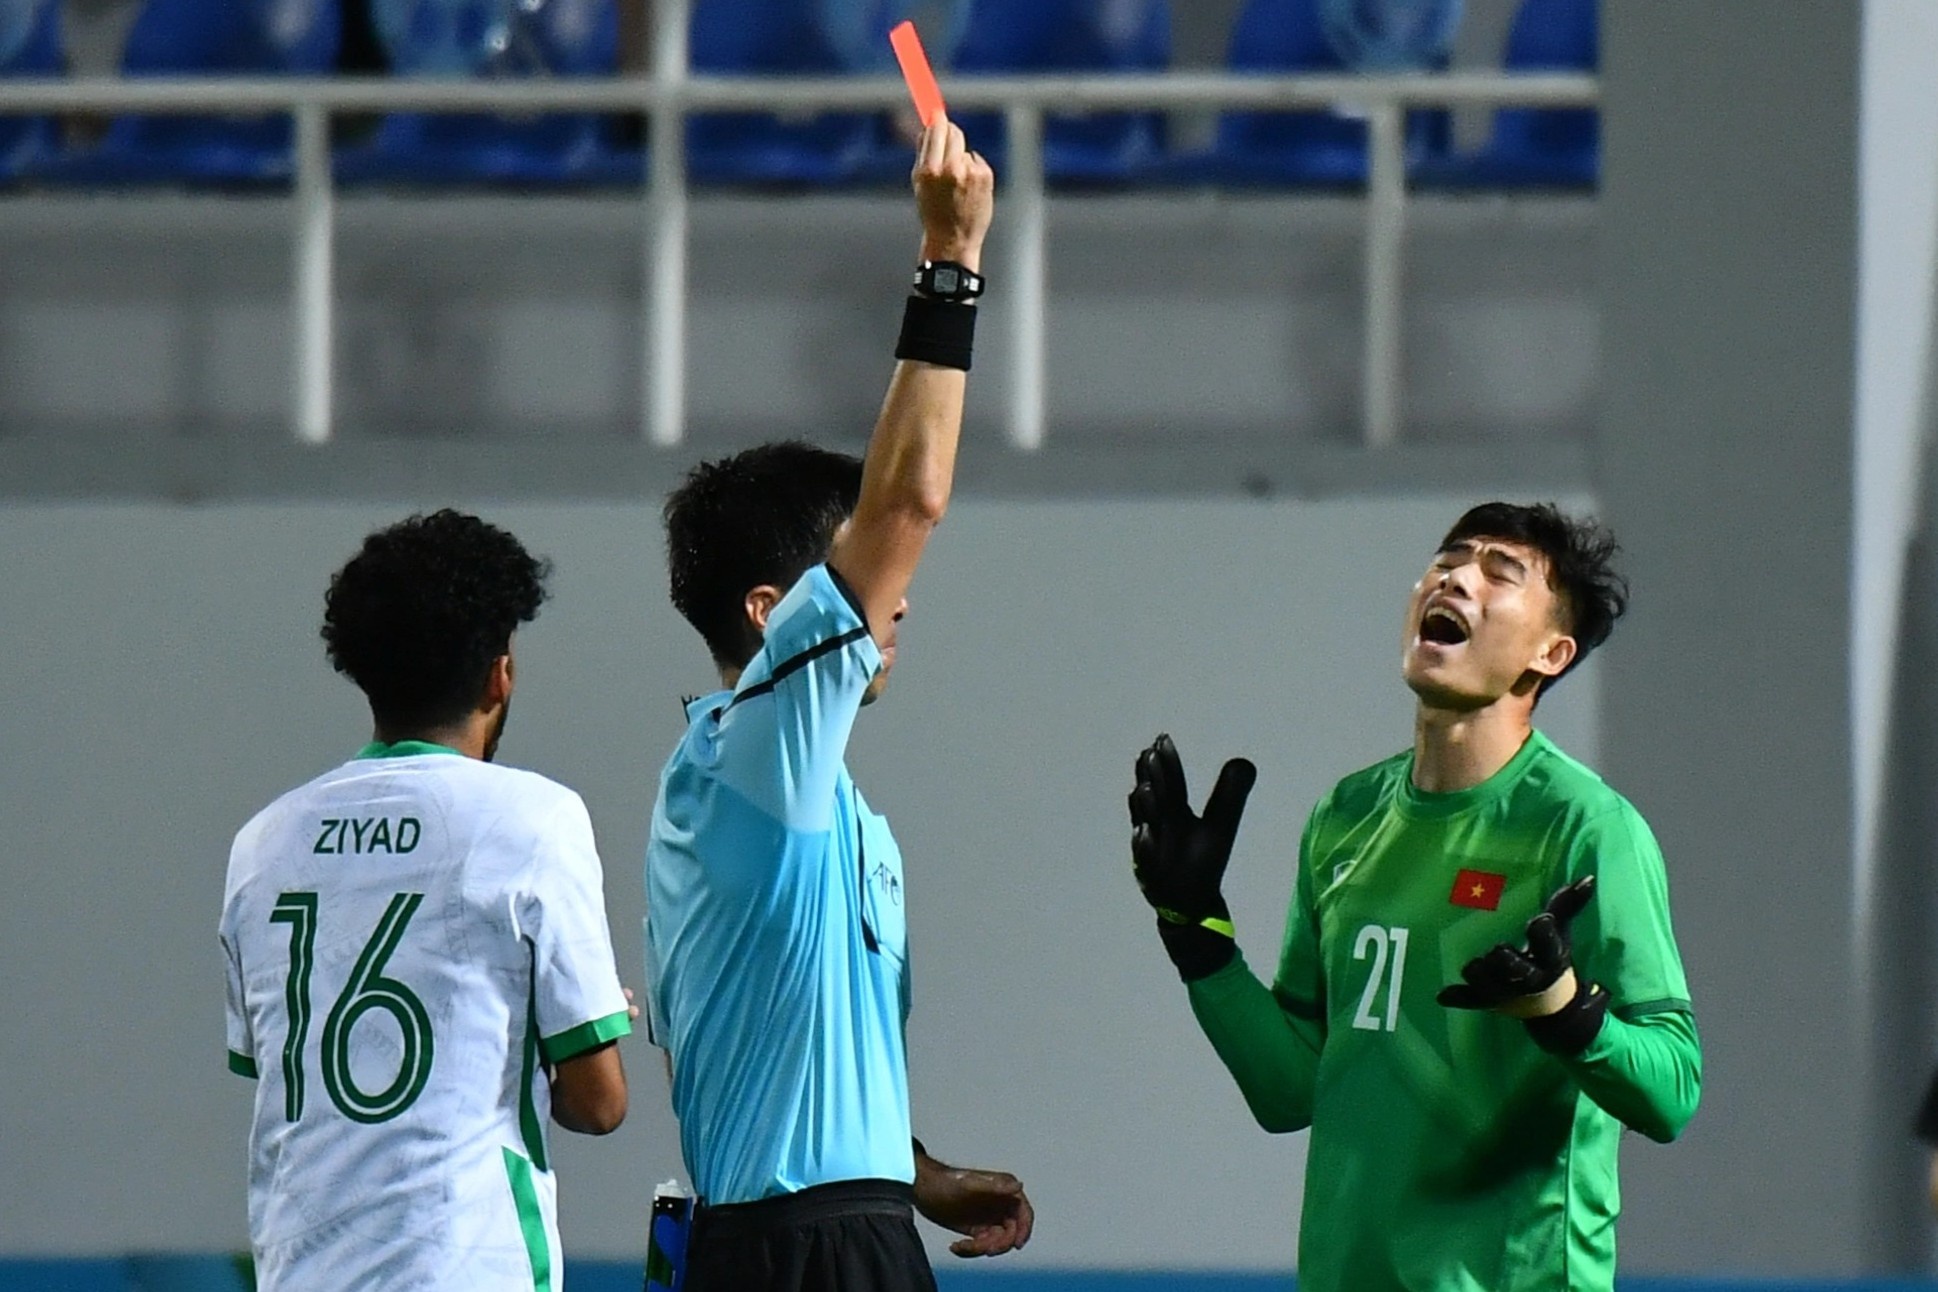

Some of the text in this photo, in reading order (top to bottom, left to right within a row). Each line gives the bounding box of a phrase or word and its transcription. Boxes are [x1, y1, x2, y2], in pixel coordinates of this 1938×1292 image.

[313, 817, 421, 855] ZIYAD
[269, 892, 434, 1124] 16
[1352, 924, 1409, 1032] 21
